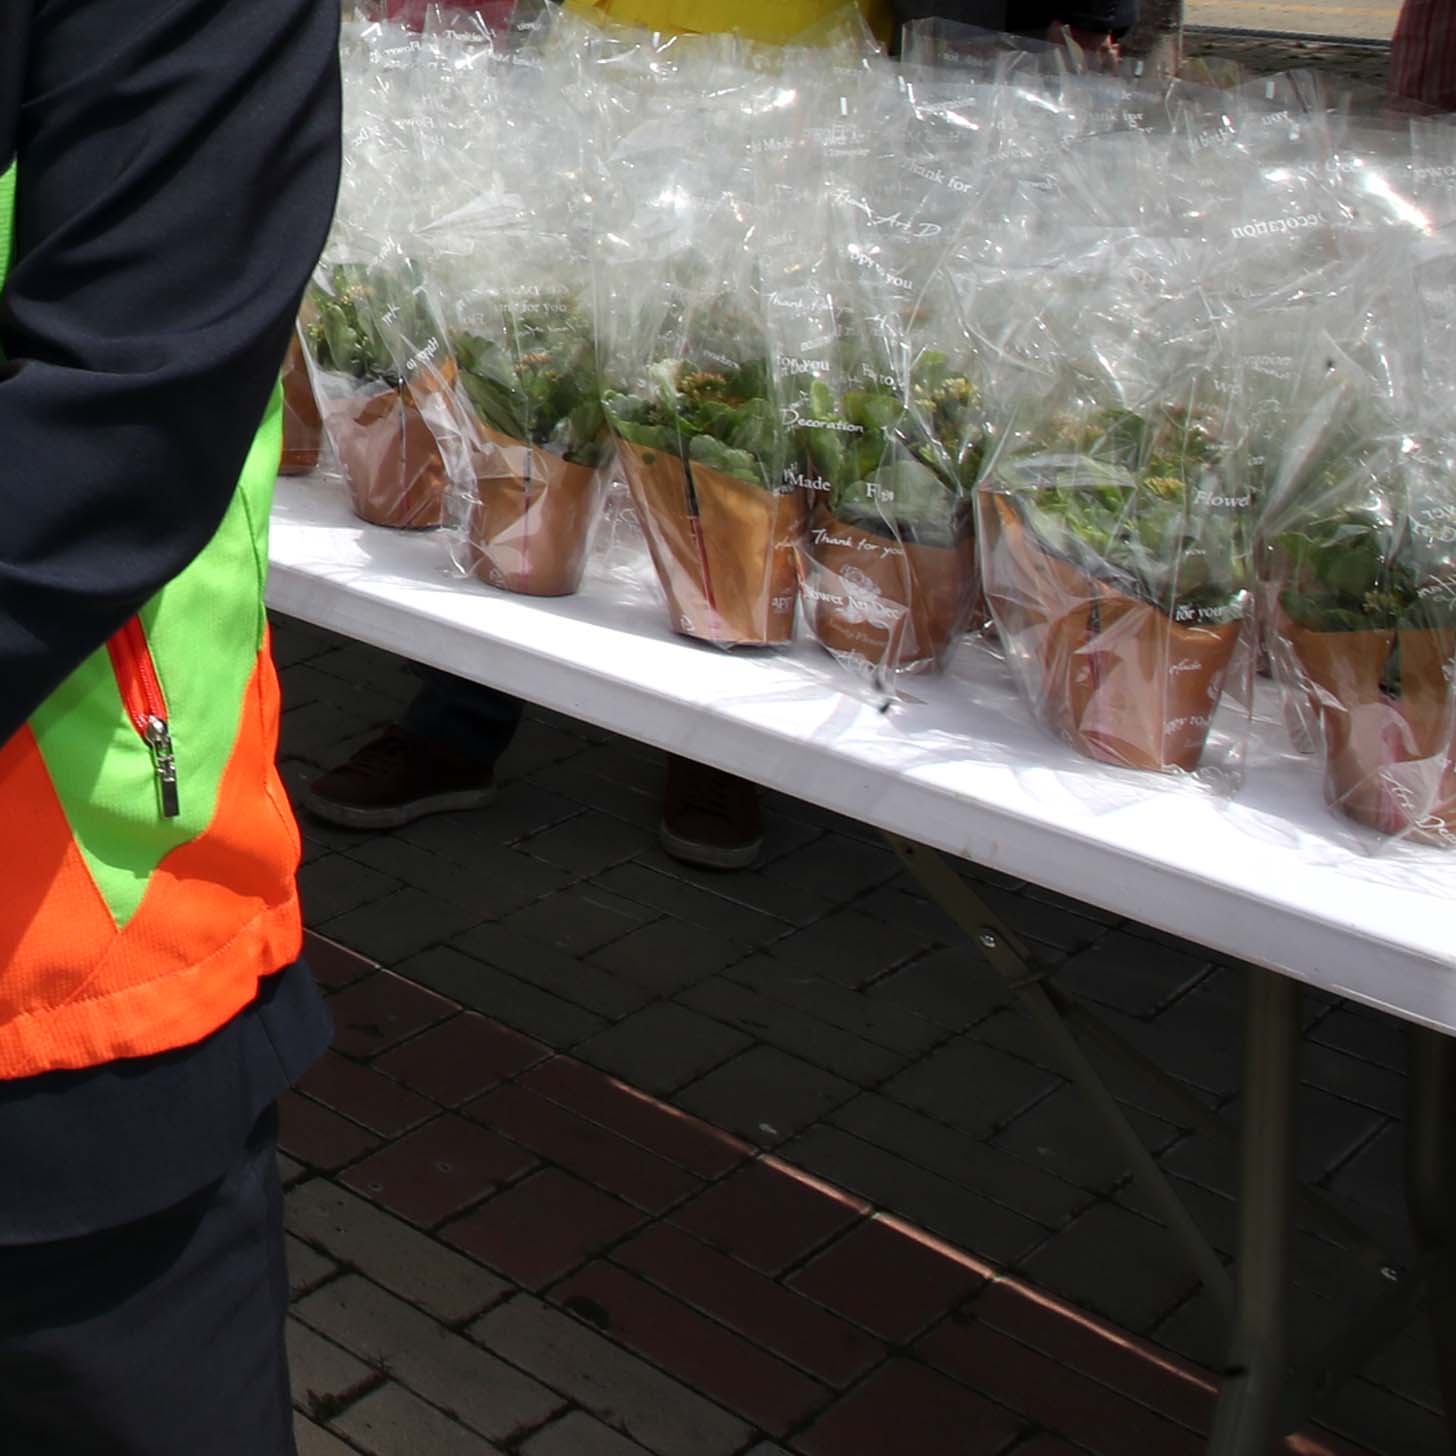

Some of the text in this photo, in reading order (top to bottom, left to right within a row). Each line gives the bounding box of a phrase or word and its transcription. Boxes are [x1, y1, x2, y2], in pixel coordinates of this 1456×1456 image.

[781, 407, 865, 434] Decoration
[789, 471, 832, 493] Made
[810, 527, 853, 548] Thank
